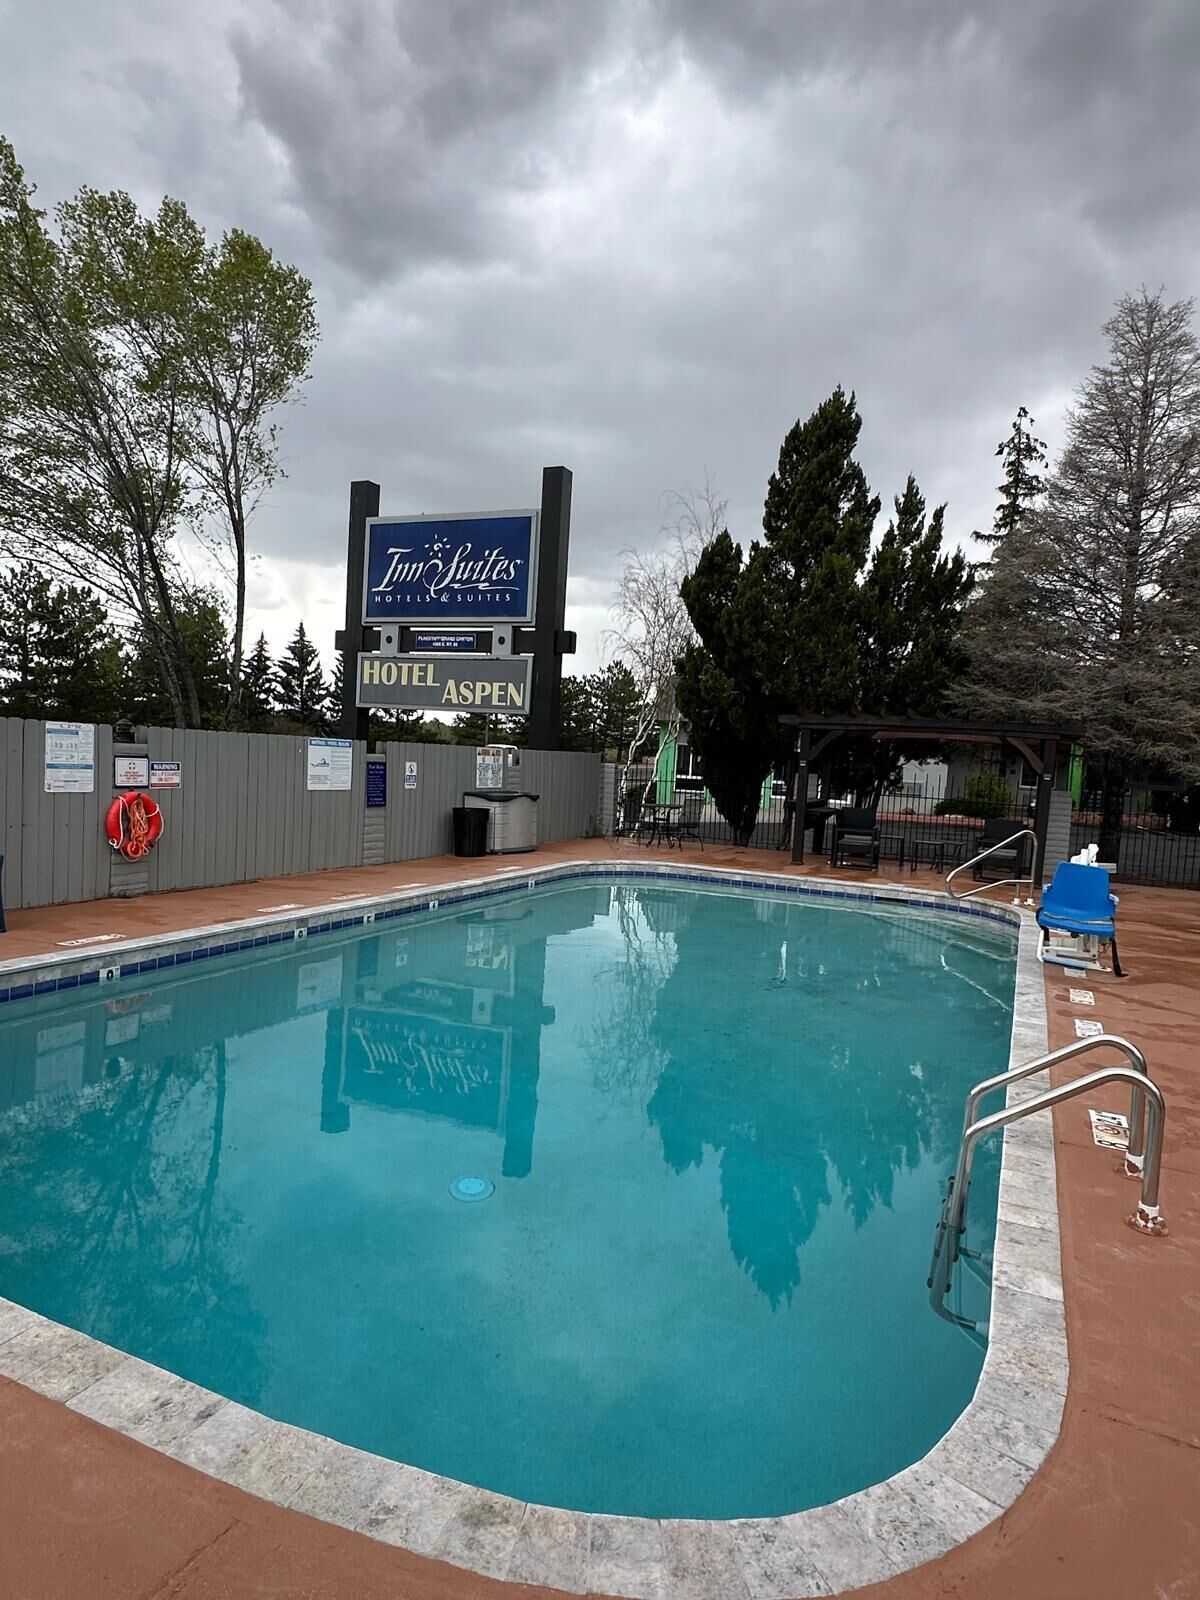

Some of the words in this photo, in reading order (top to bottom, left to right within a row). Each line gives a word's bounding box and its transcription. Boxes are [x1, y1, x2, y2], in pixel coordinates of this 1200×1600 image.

[375, 595, 430, 603] HOTELS
[440, 592, 450, 603] &
[457, 593, 511, 603] SUITES
[363, 660, 440, 686] HOTEL
[441, 679, 524, 706] ASPEN
